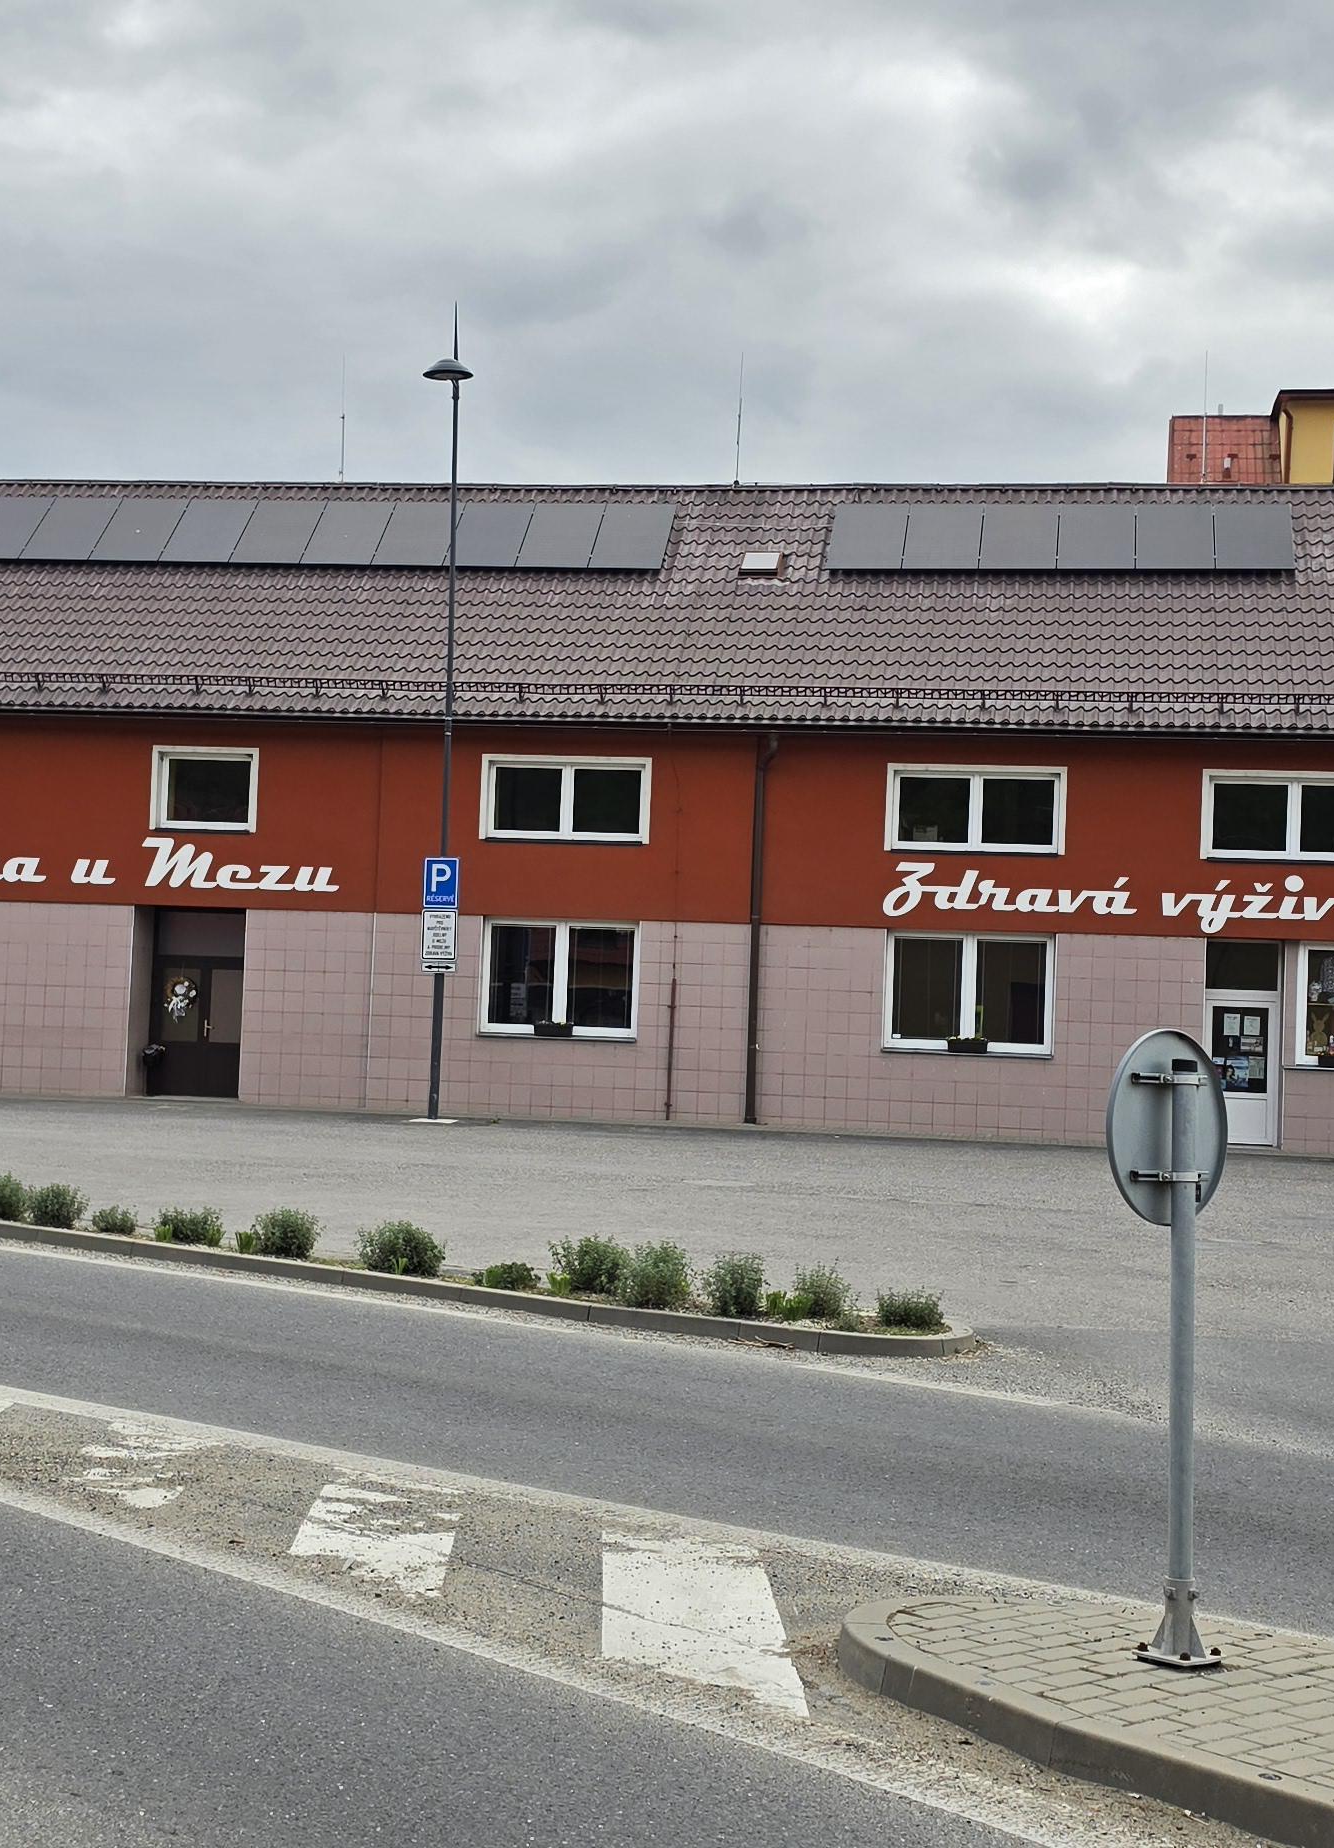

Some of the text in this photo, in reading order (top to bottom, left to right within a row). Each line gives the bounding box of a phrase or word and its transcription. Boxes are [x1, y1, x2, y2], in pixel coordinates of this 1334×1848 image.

[71, 858, 116, 885] u
[142, 837, 340, 893] Mezu
[431, 863, 452, 892] P
[883, 861, 1138, 917] Zdravá
